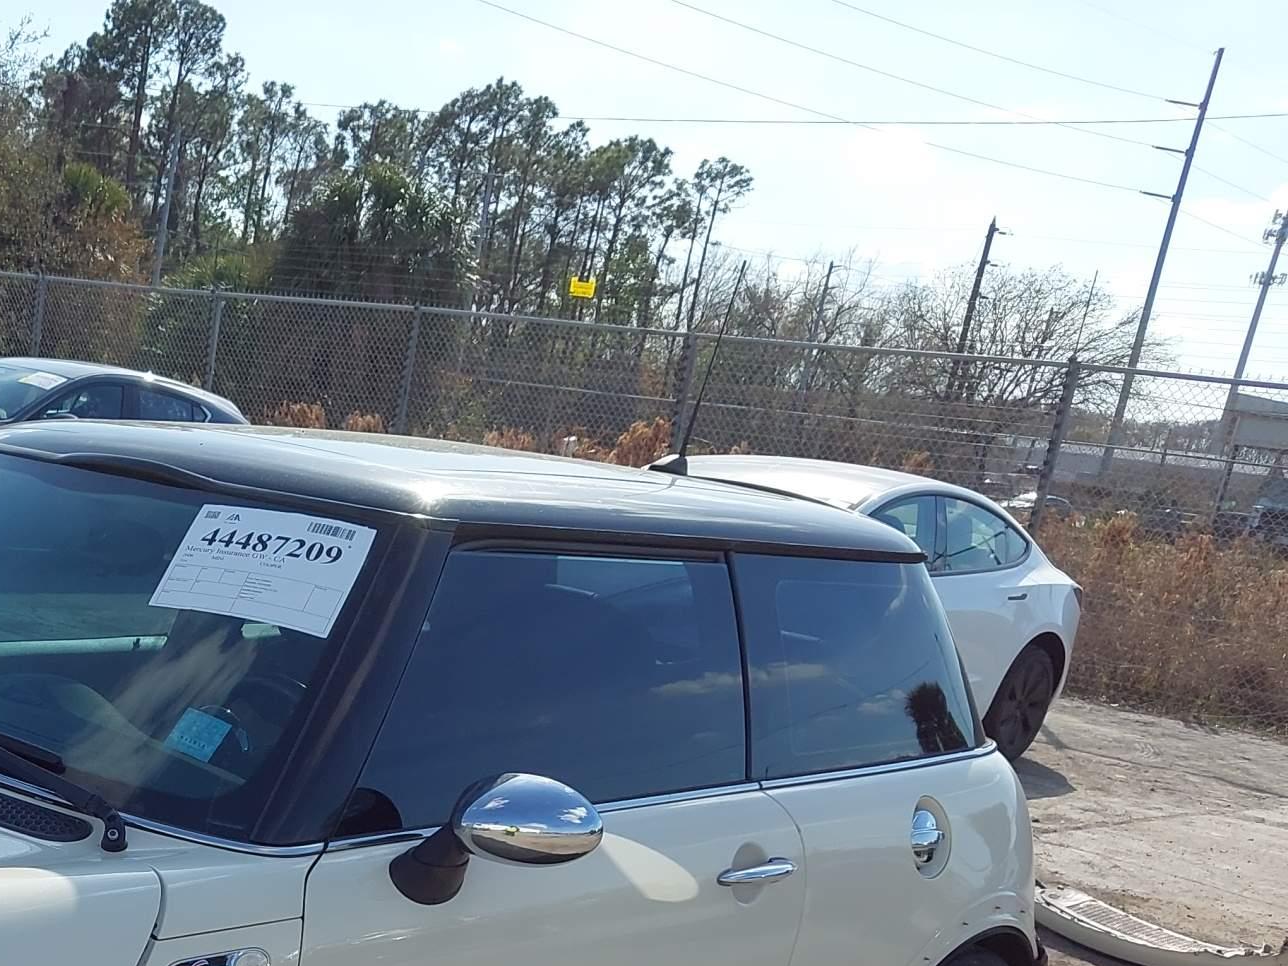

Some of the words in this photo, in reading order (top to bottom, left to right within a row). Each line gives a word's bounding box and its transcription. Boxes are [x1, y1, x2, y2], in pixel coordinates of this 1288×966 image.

[185, 545, 214, 554] Mercury
[216, 548, 250, 558] Insurance
[201, 527, 343, 565] 44487209
